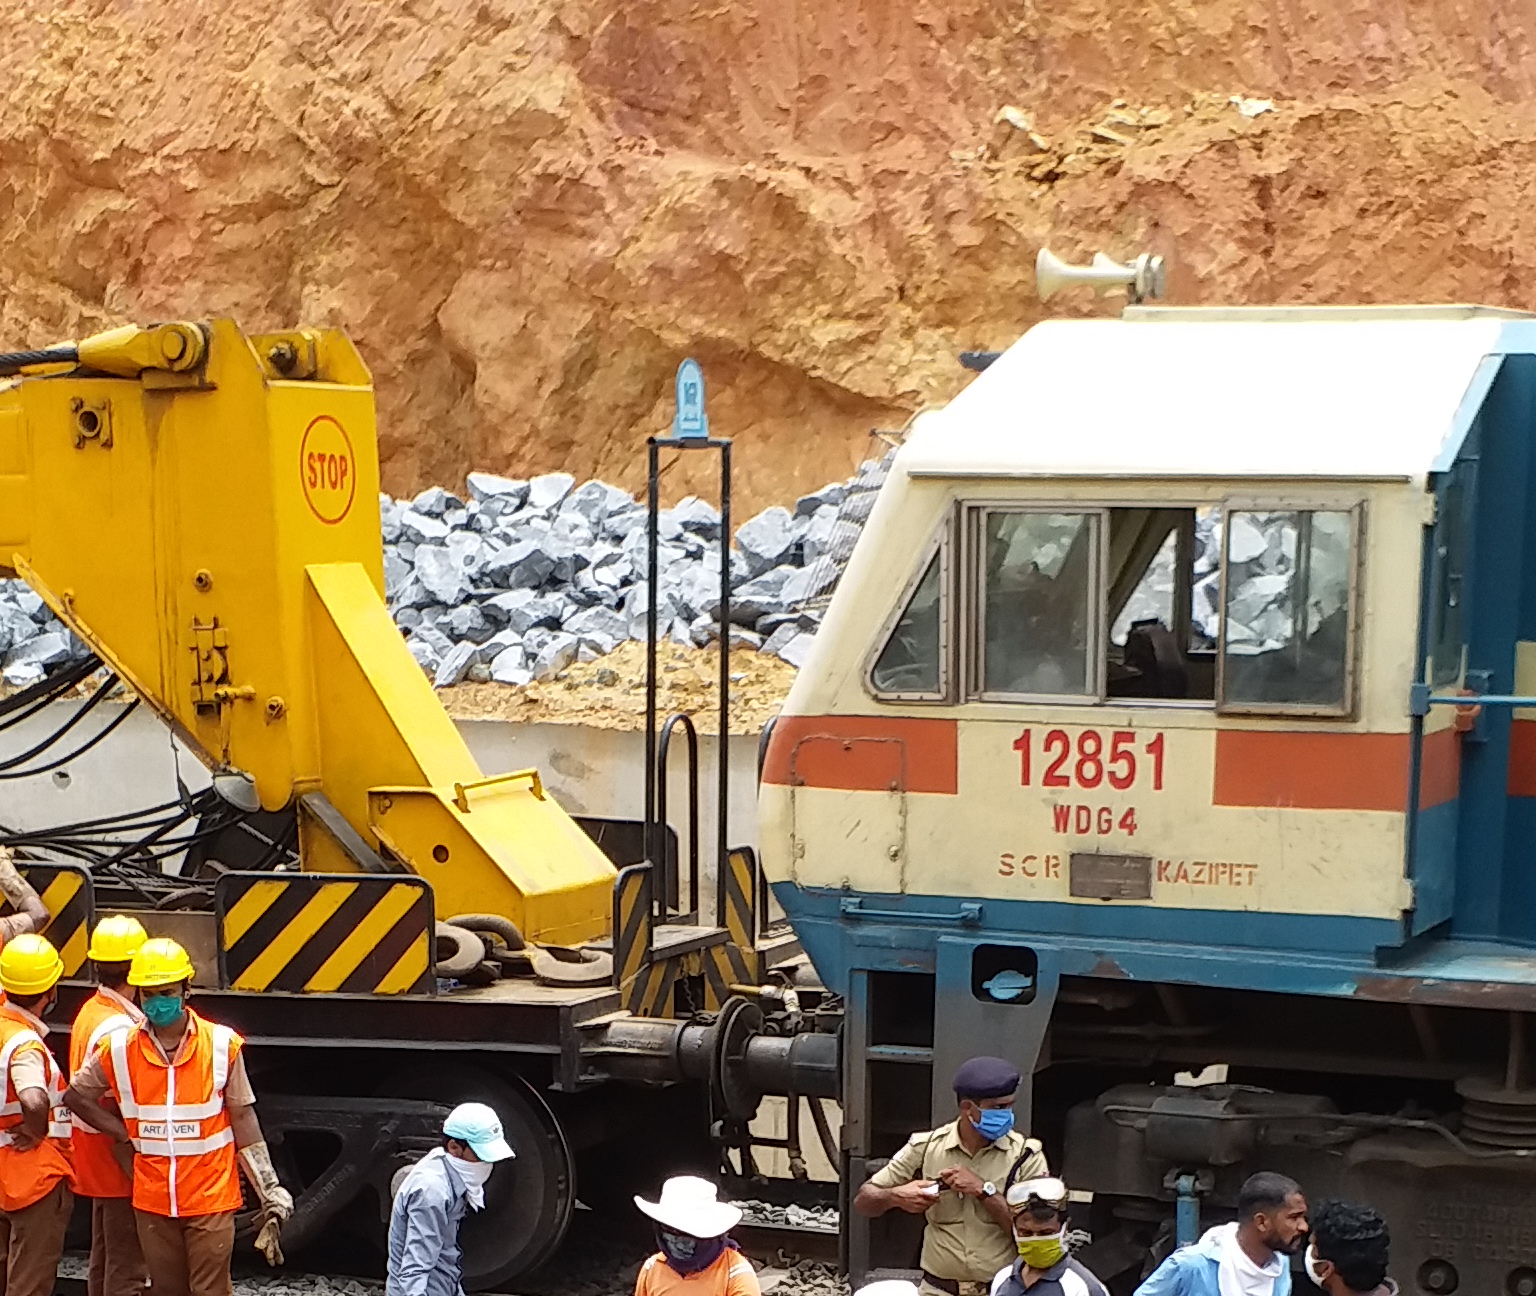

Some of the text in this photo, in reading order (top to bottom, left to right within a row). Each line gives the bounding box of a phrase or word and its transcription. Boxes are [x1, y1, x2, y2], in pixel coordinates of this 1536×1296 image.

[307, 451, 348, 491] STOP
[1011, 727, 1166, 792] 12851
[1052, 803, 1139, 837] WDG4
[998, 851, 1062, 880] SCR
[1155, 859, 1261, 889] KAZIPET
[142, 1124, 162, 1135] ART
[173, 1124, 196, 1134] VEN
